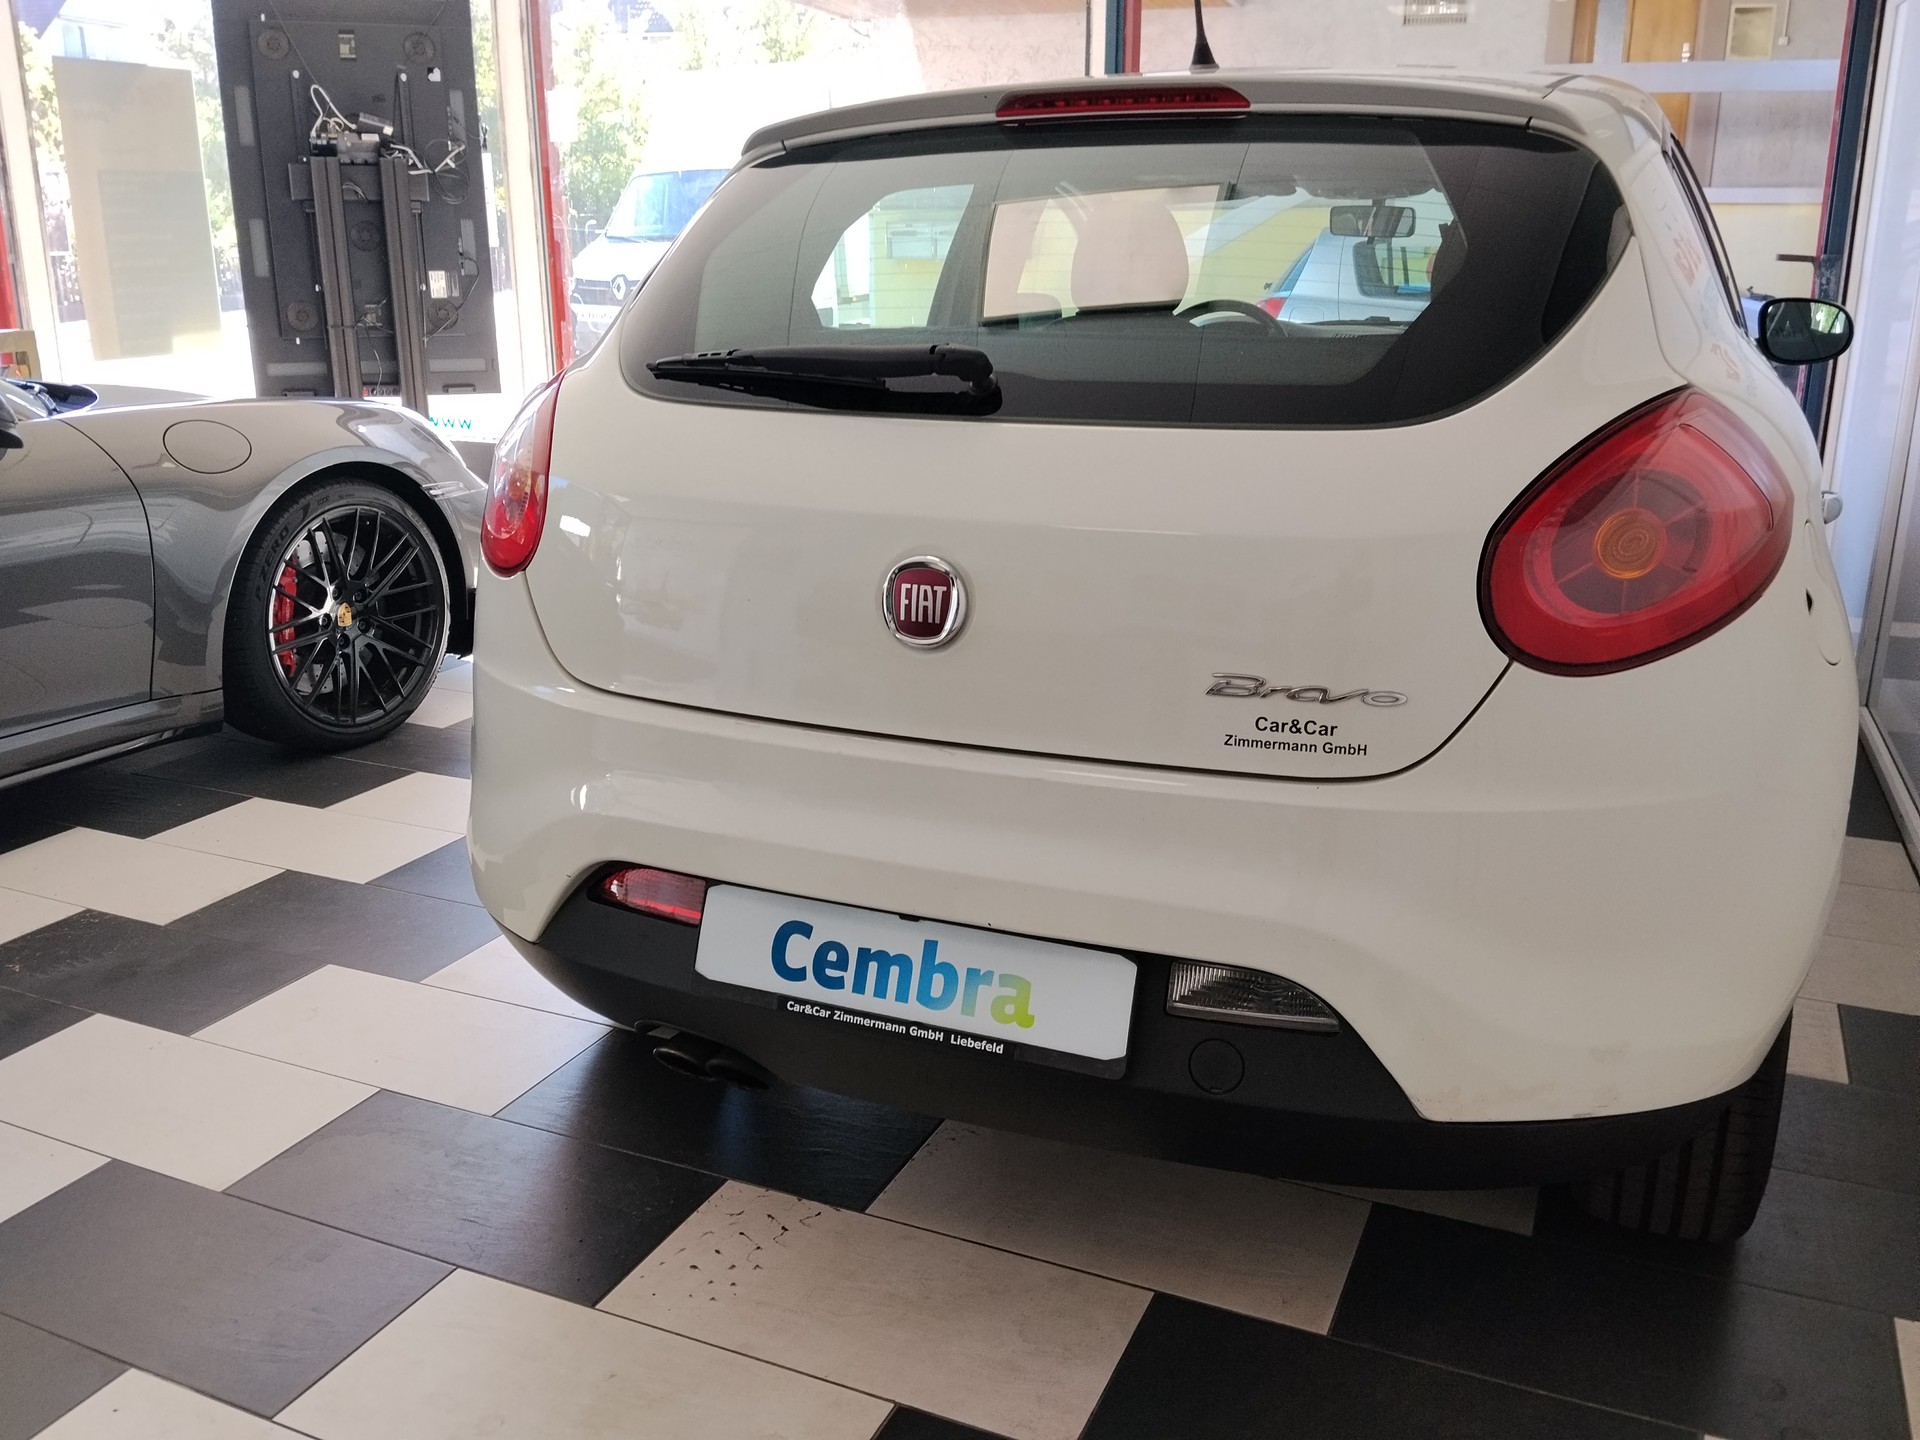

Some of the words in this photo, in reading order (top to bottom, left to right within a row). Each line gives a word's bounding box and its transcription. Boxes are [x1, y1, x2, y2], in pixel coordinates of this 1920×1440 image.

[900, 583, 947, 624] FIAT
[1204, 672, 1408, 707] Bravo
[1223, 734, 1317, 753] Zimmermann
[1322, 741, 1368, 756] GmbH
[1254, 716, 1338, 737] Car&Car
[771, 919, 1035, 1029] Cembra
[786, 1001, 831, 1019] Car&Car
[833, 1010, 906, 1034] Zimmermann
[909, 1026, 944, 1042] GmbH
[950, 1034, 1004, 1054] Liebefeld
